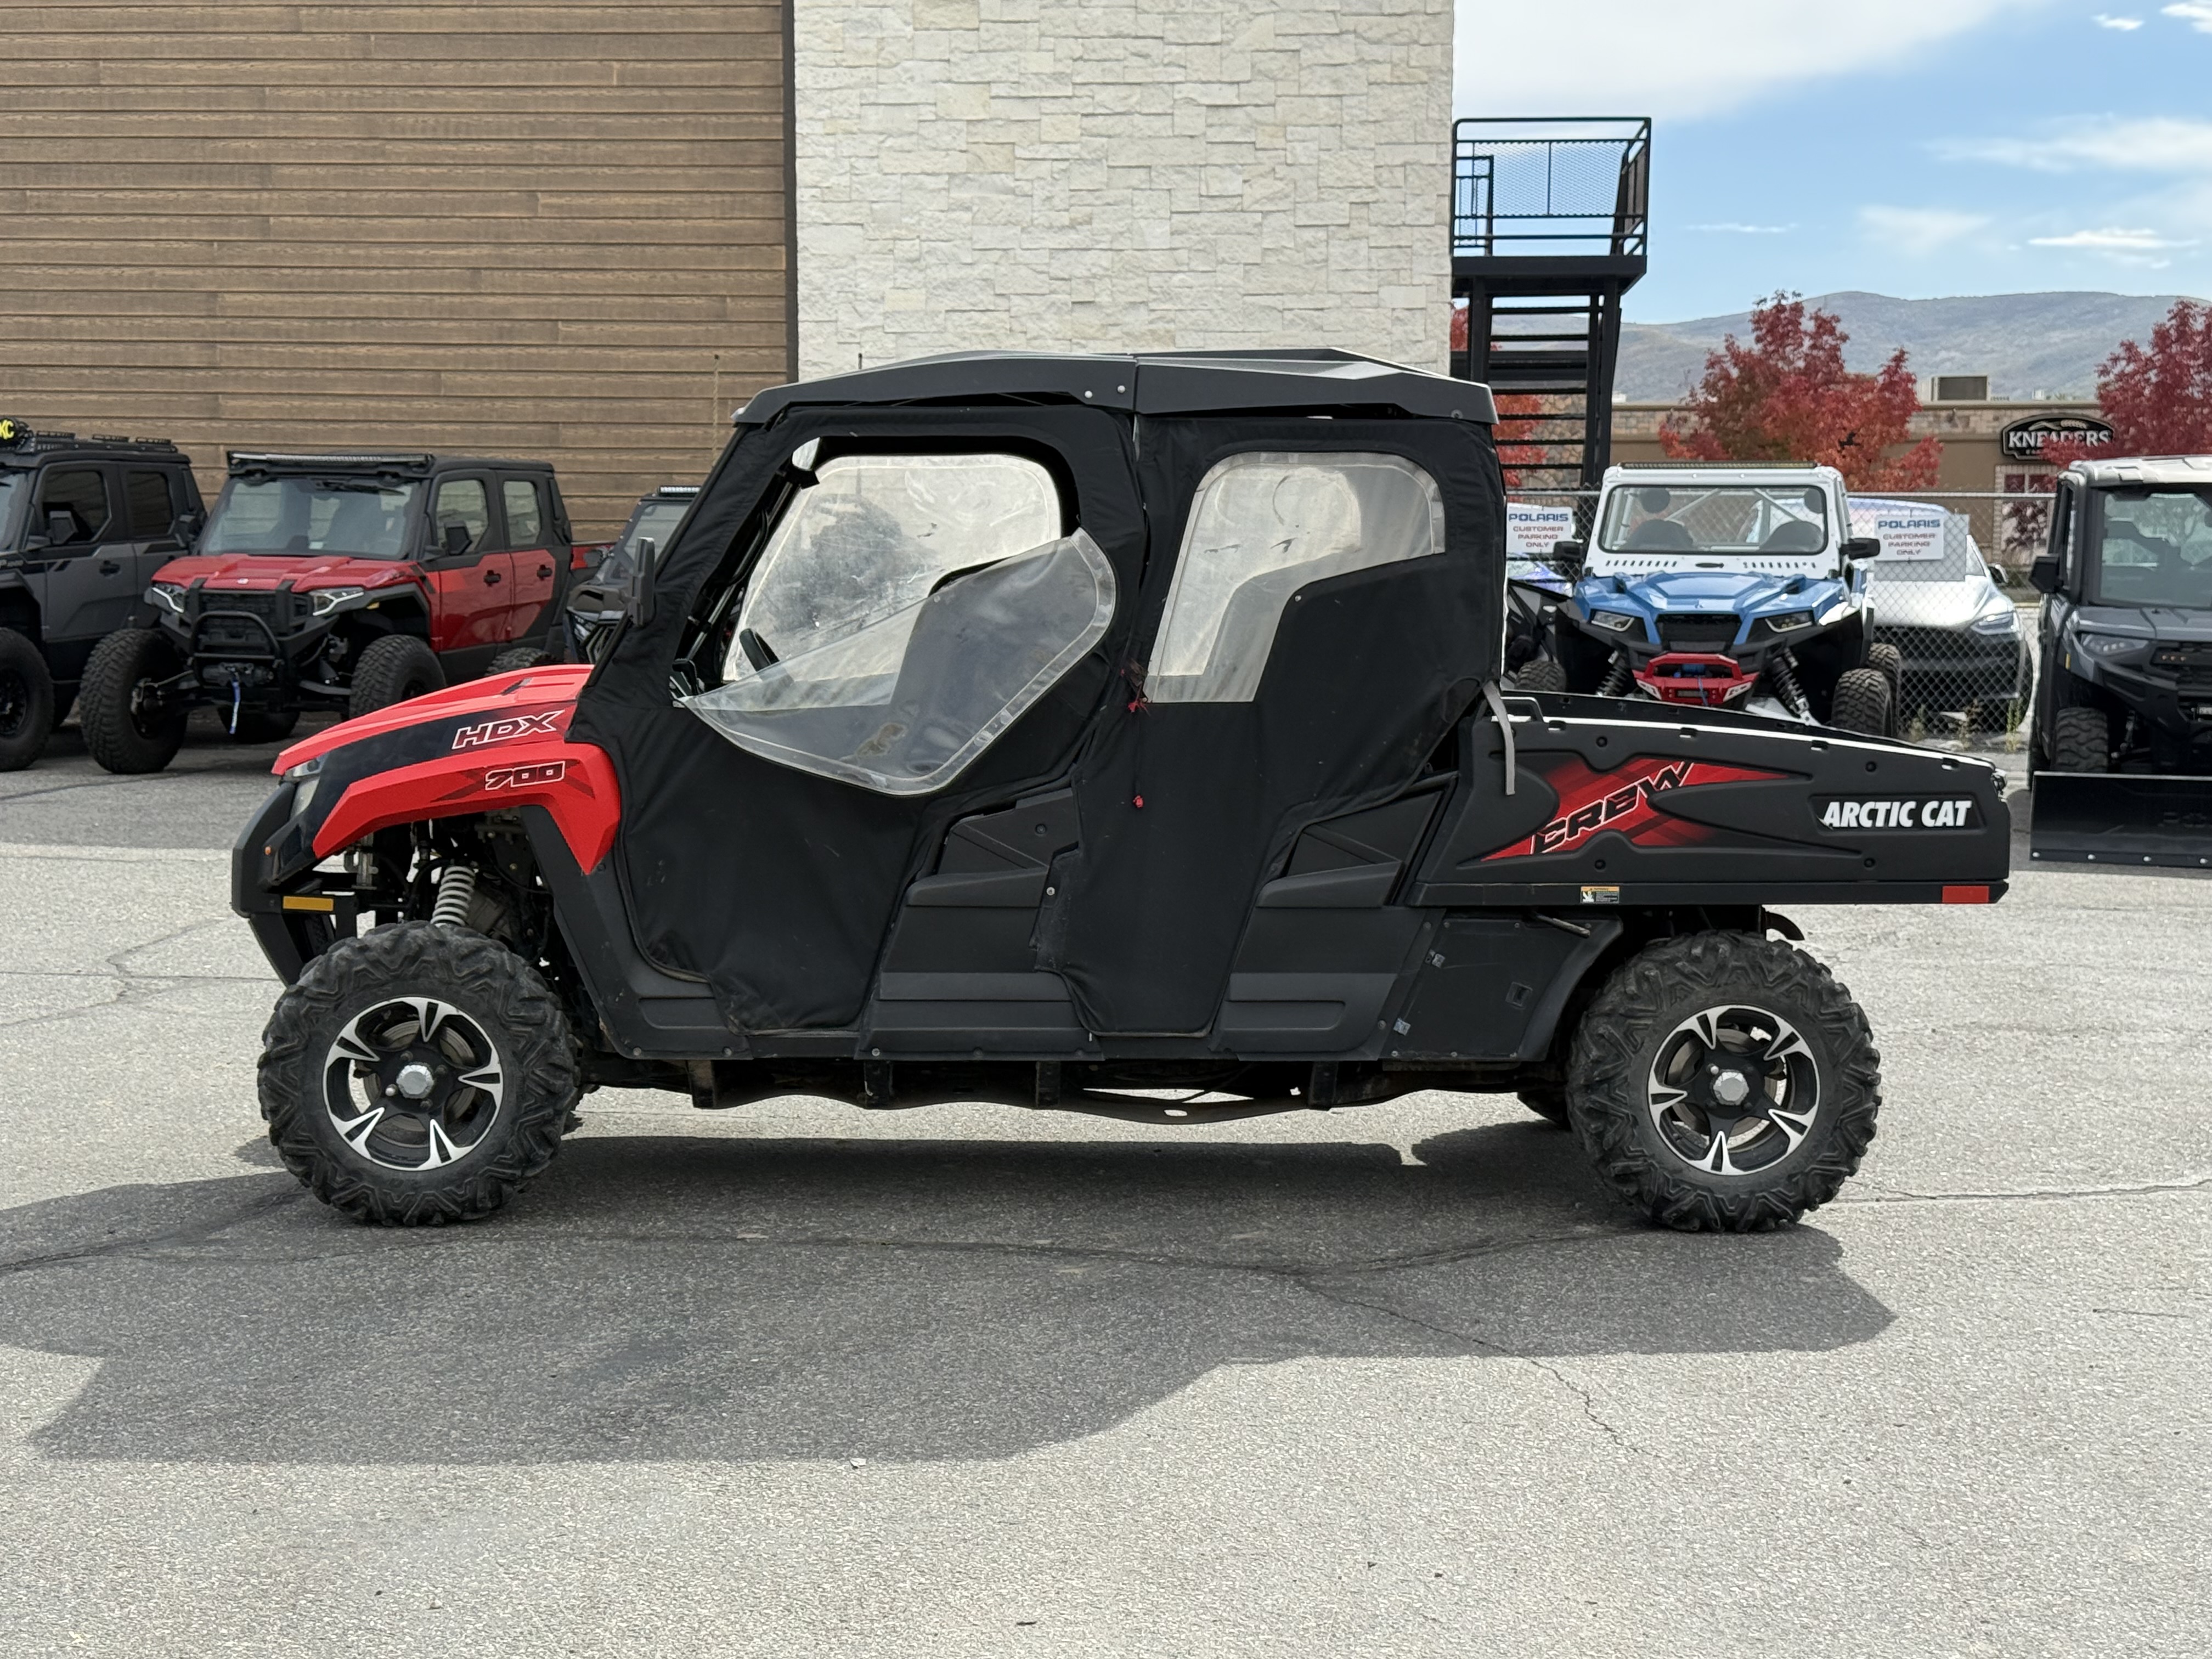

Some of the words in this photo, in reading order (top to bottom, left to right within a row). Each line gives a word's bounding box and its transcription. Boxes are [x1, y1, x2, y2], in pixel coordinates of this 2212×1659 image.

[1509, 513, 1568, 522] POLARIS
[1878, 519, 1940, 529] POLARIS
[452, 709, 565, 749] HDX
[485, 760, 566, 791] 700
[1530, 761, 1694, 854] CREW
[1822, 800, 1917, 828] ARCTIC
[1921, 800, 1972, 827] CAT
